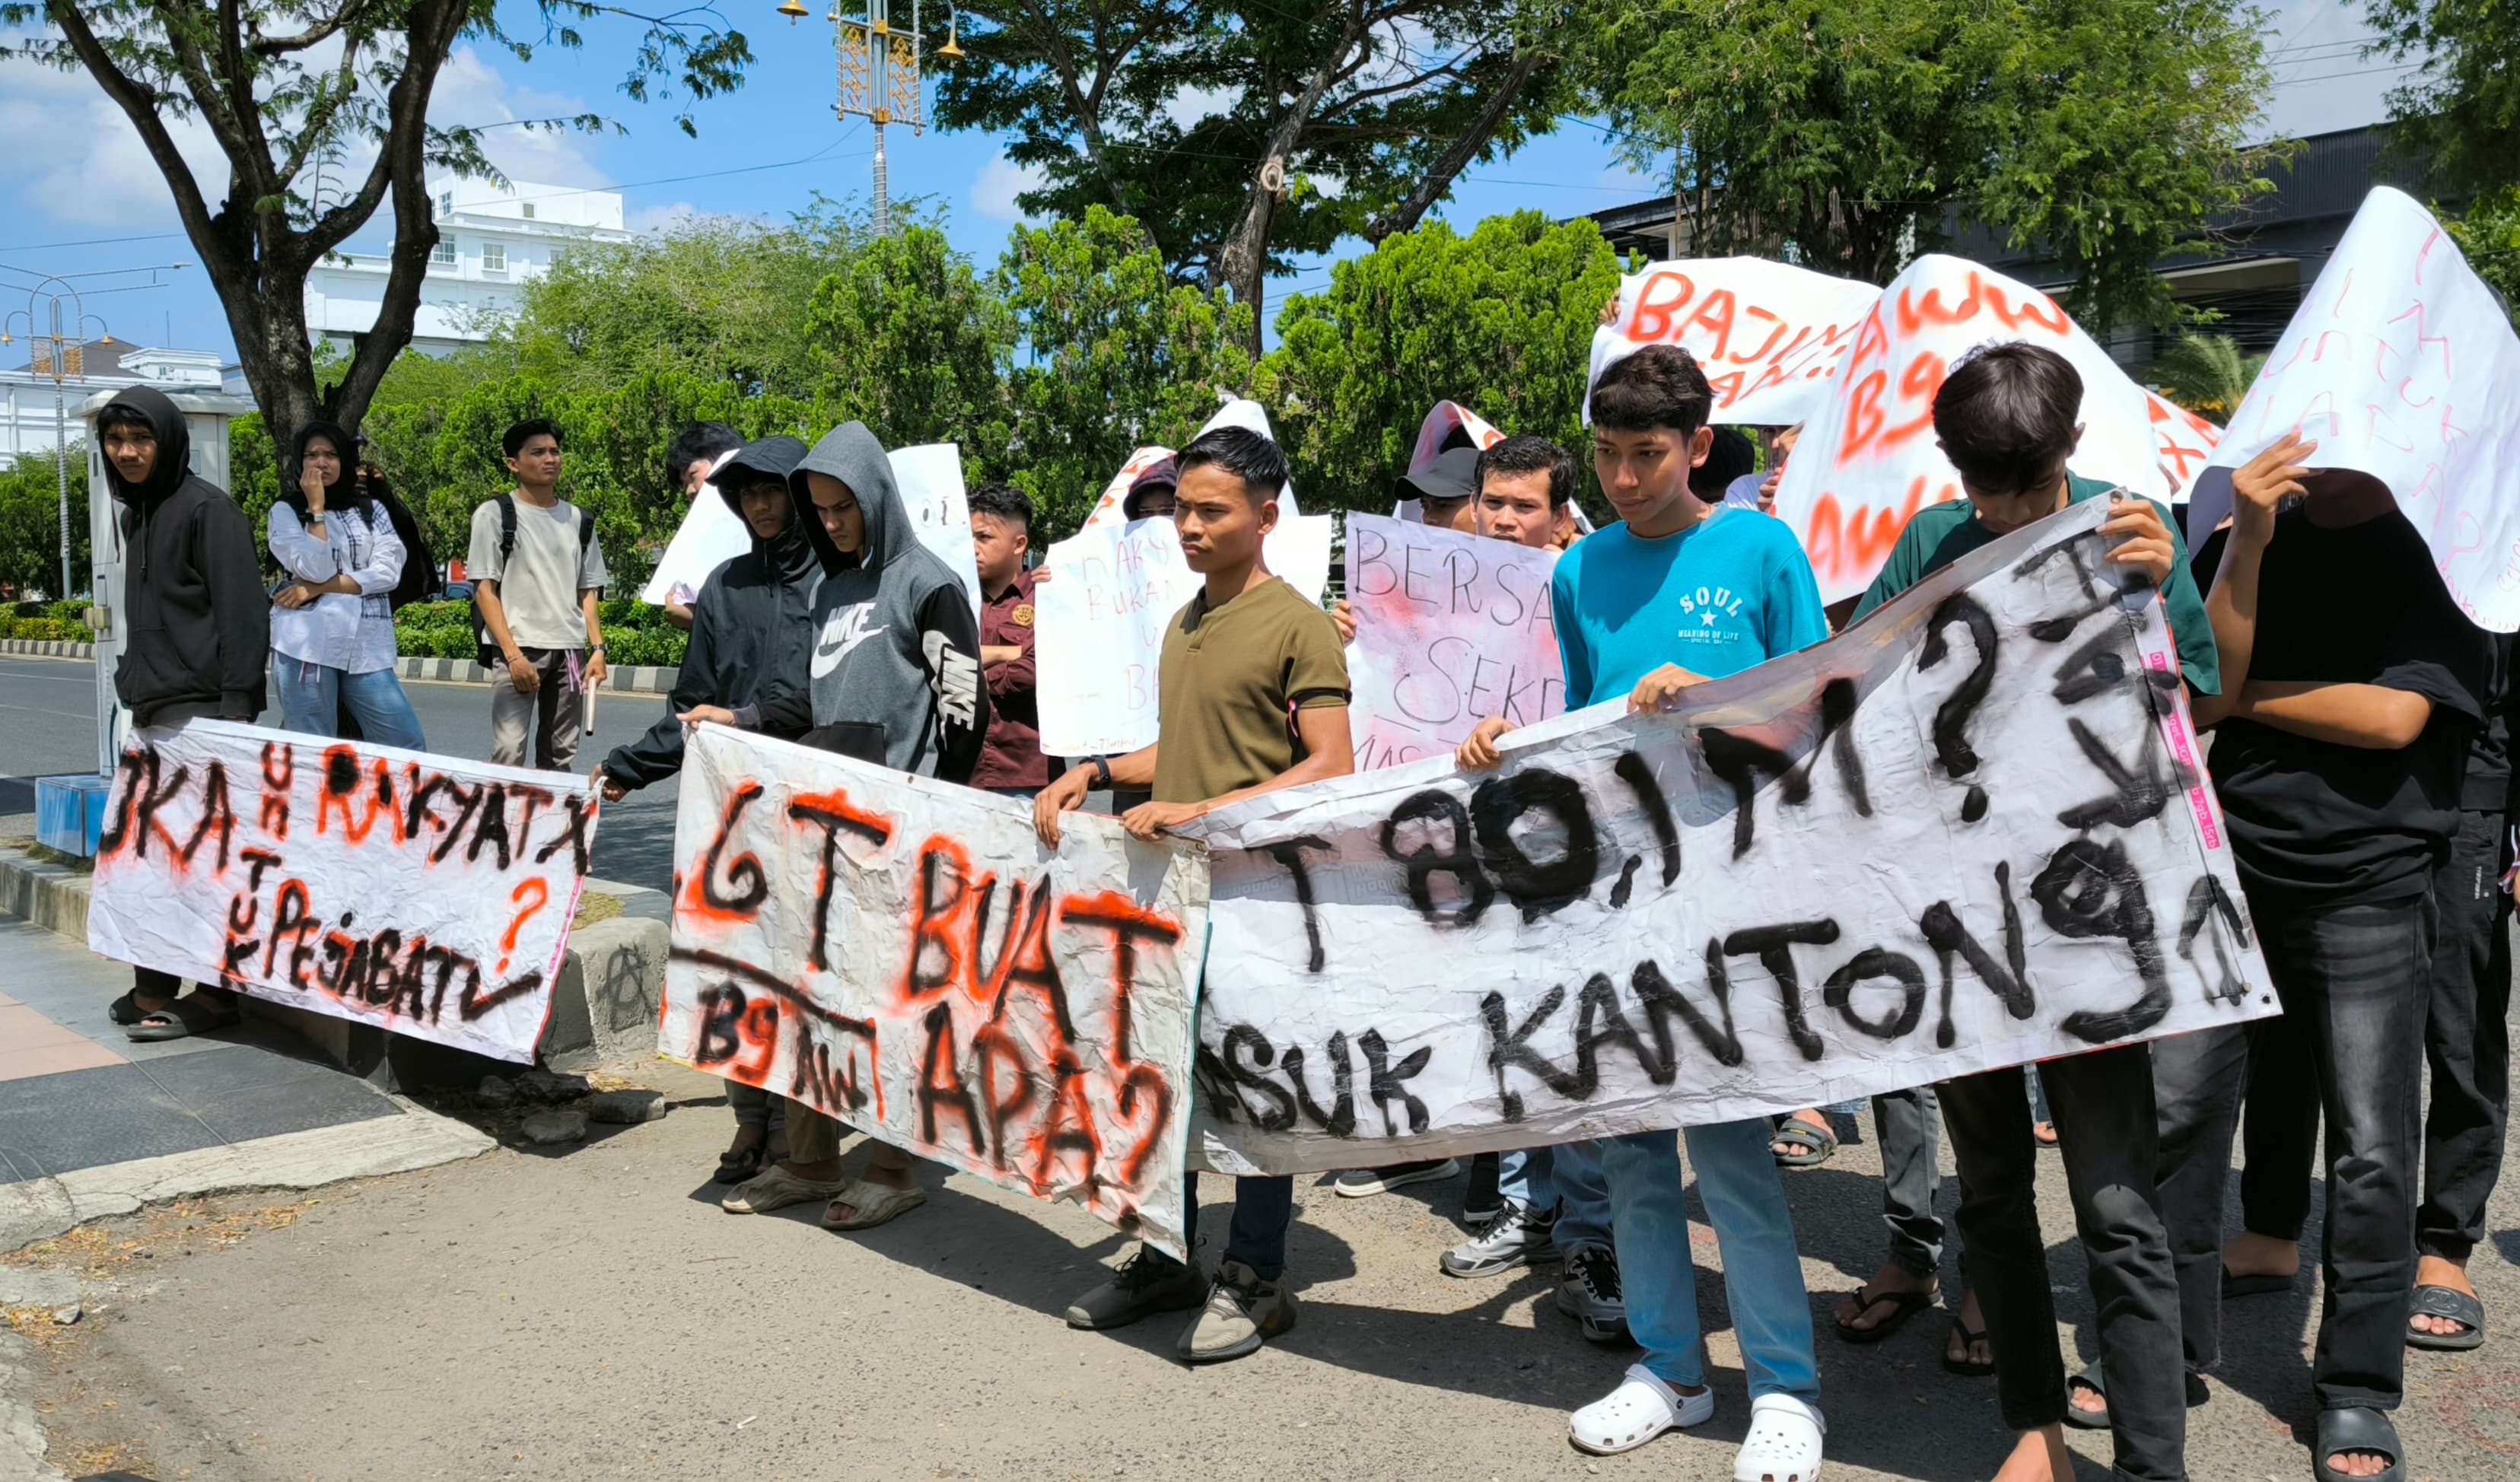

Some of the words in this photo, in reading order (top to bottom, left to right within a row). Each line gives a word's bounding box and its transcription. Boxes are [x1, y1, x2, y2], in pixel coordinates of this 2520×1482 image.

[1679, 587, 1743, 618] SOUL
[819, 603, 877, 645] NIKE
[1711, 630, 1722, 639] OF
[1723, 631, 1739, 641] LIFE
[942, 647, 978, 731] NIKE
[904, 833, 1185, 1069] BUAT
